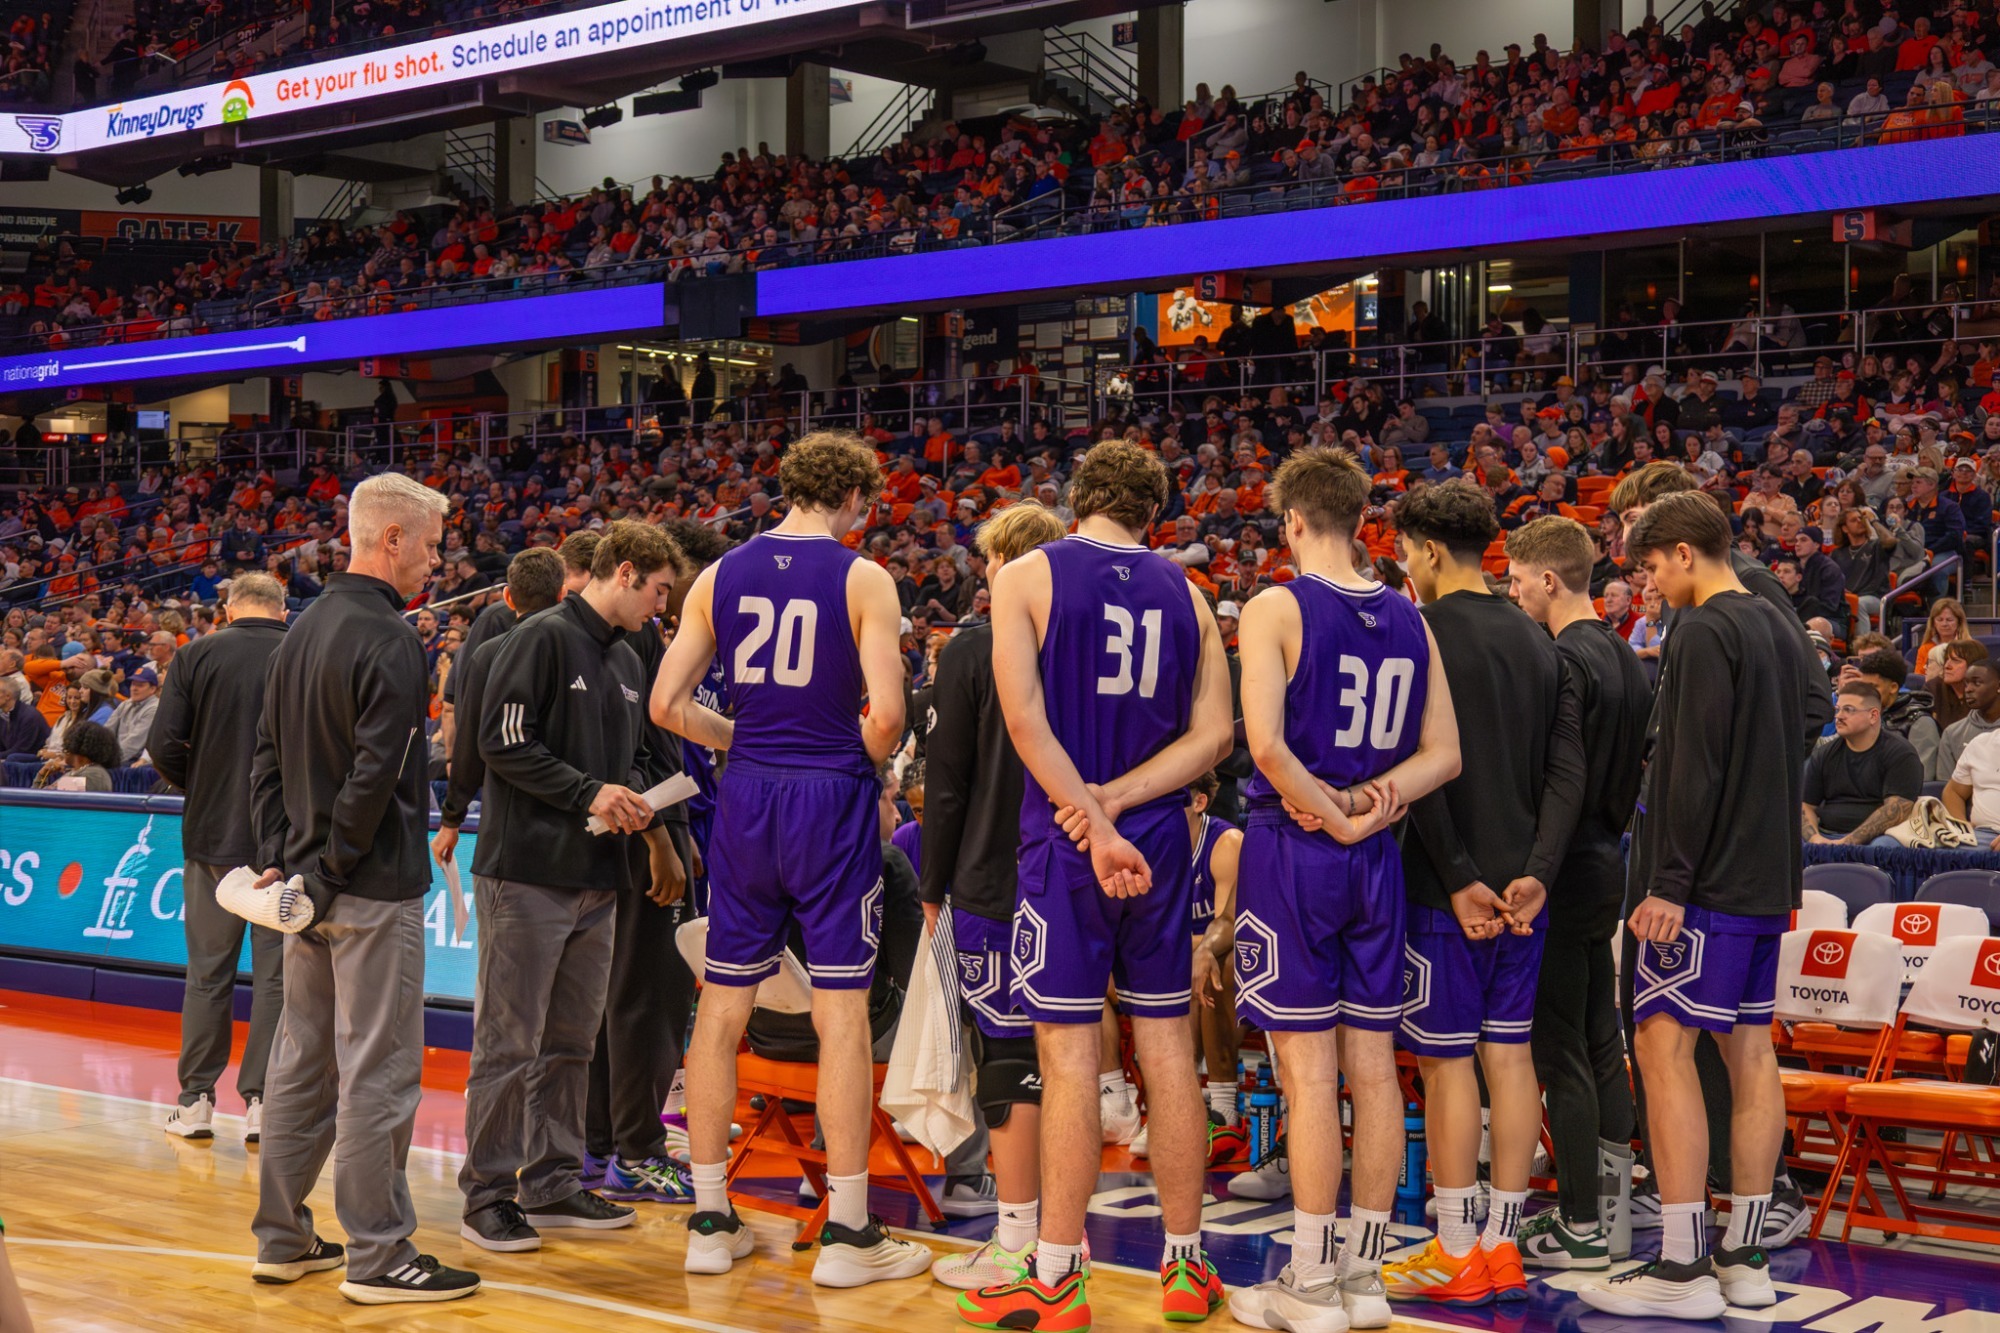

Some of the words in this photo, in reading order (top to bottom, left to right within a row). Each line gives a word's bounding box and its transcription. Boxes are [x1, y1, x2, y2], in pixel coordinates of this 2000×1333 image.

[276, 77, 310, 102] Get
[314, 70, 358, 100] your
[362, 61, 388, 85] flu
[394, 51, 445, 79] shot.
[451, 30, 548, 68] Schedule
[554, 26, 581, 49] an
[587, 0, 732, 45] appointment
[734, 595, 818, 688] 20
[1097, 602, 1163, 699] 31
[1334, 654, 1415, 750] 30
[1789, 984, 1850, 1004] TOYOTA
